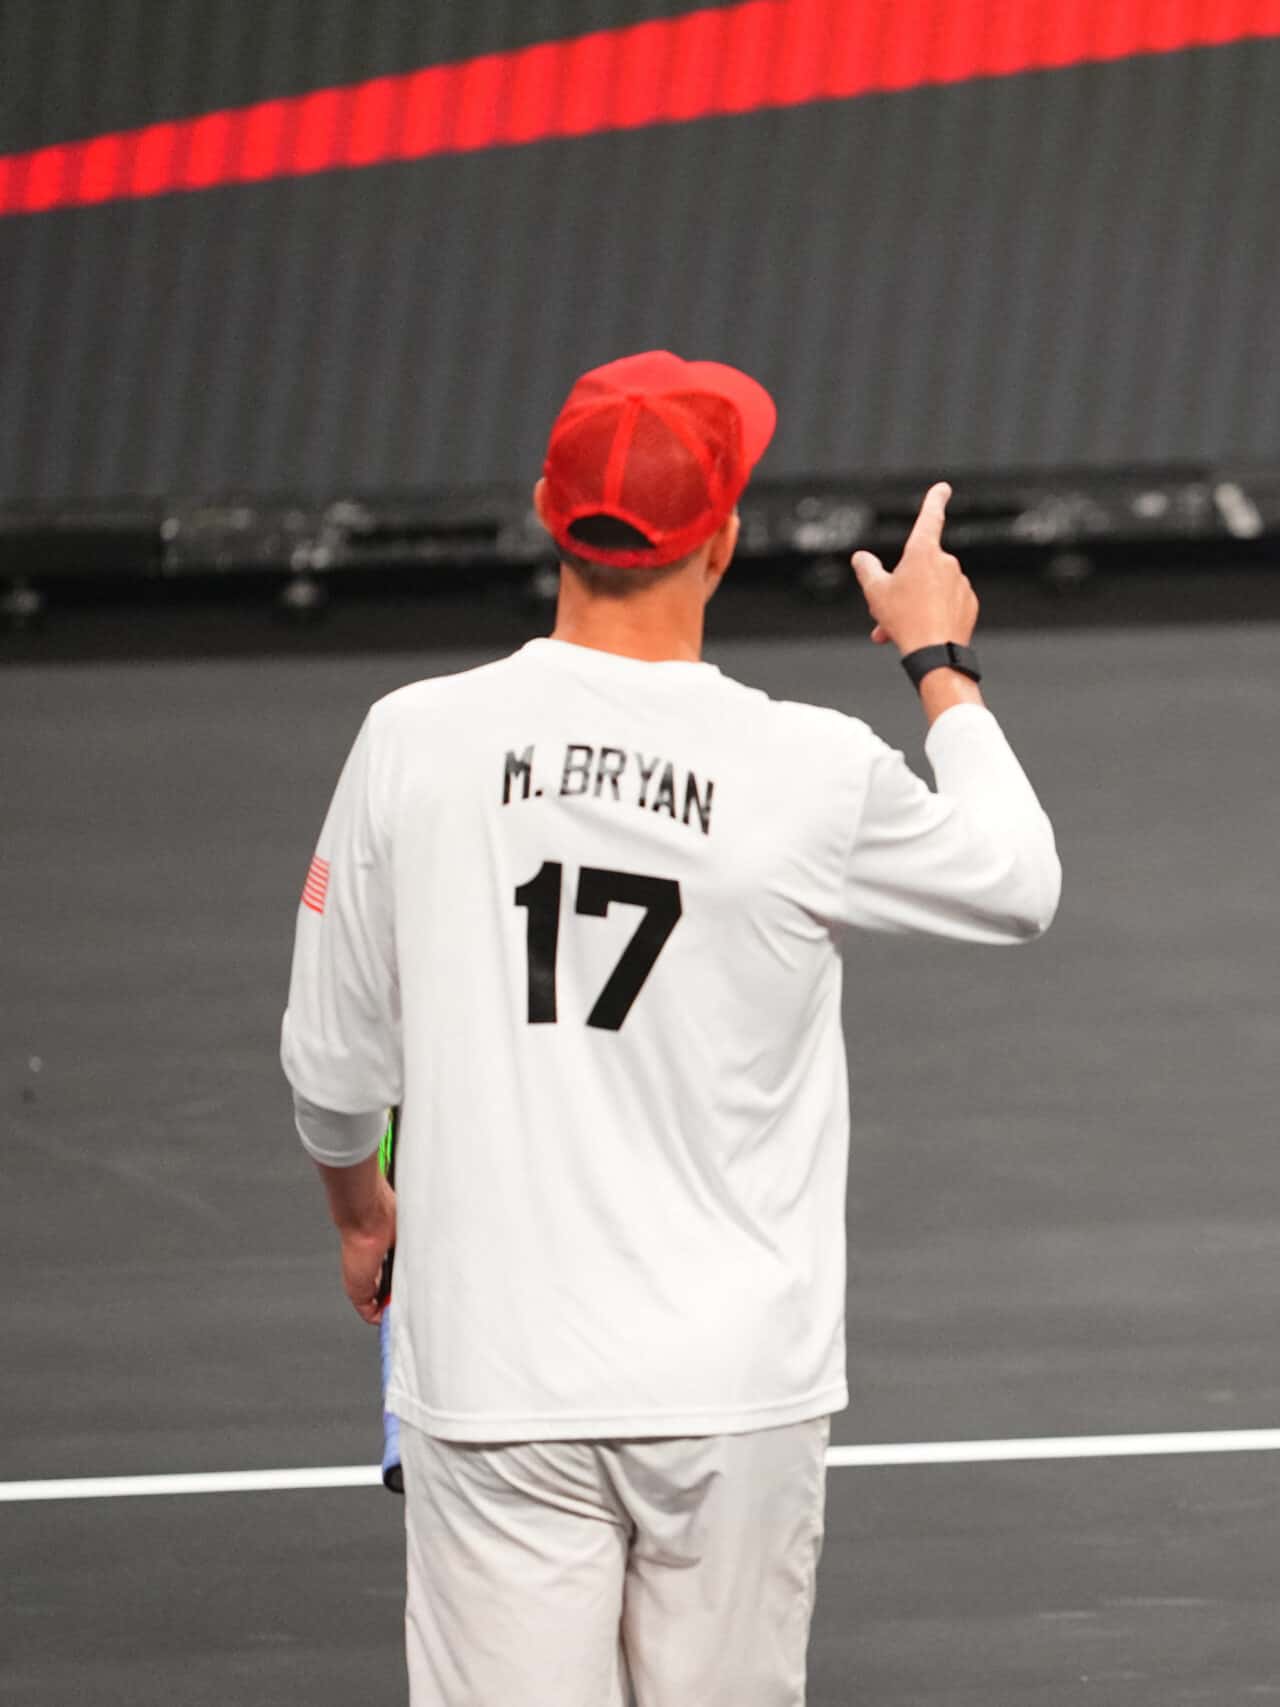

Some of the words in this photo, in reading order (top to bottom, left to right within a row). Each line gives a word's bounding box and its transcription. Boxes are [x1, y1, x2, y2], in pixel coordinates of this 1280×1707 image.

[502, 744, 543, 805] M.
[559, 744, 715, 836] BRYAN
[513, 860, 683, 1032] 17
